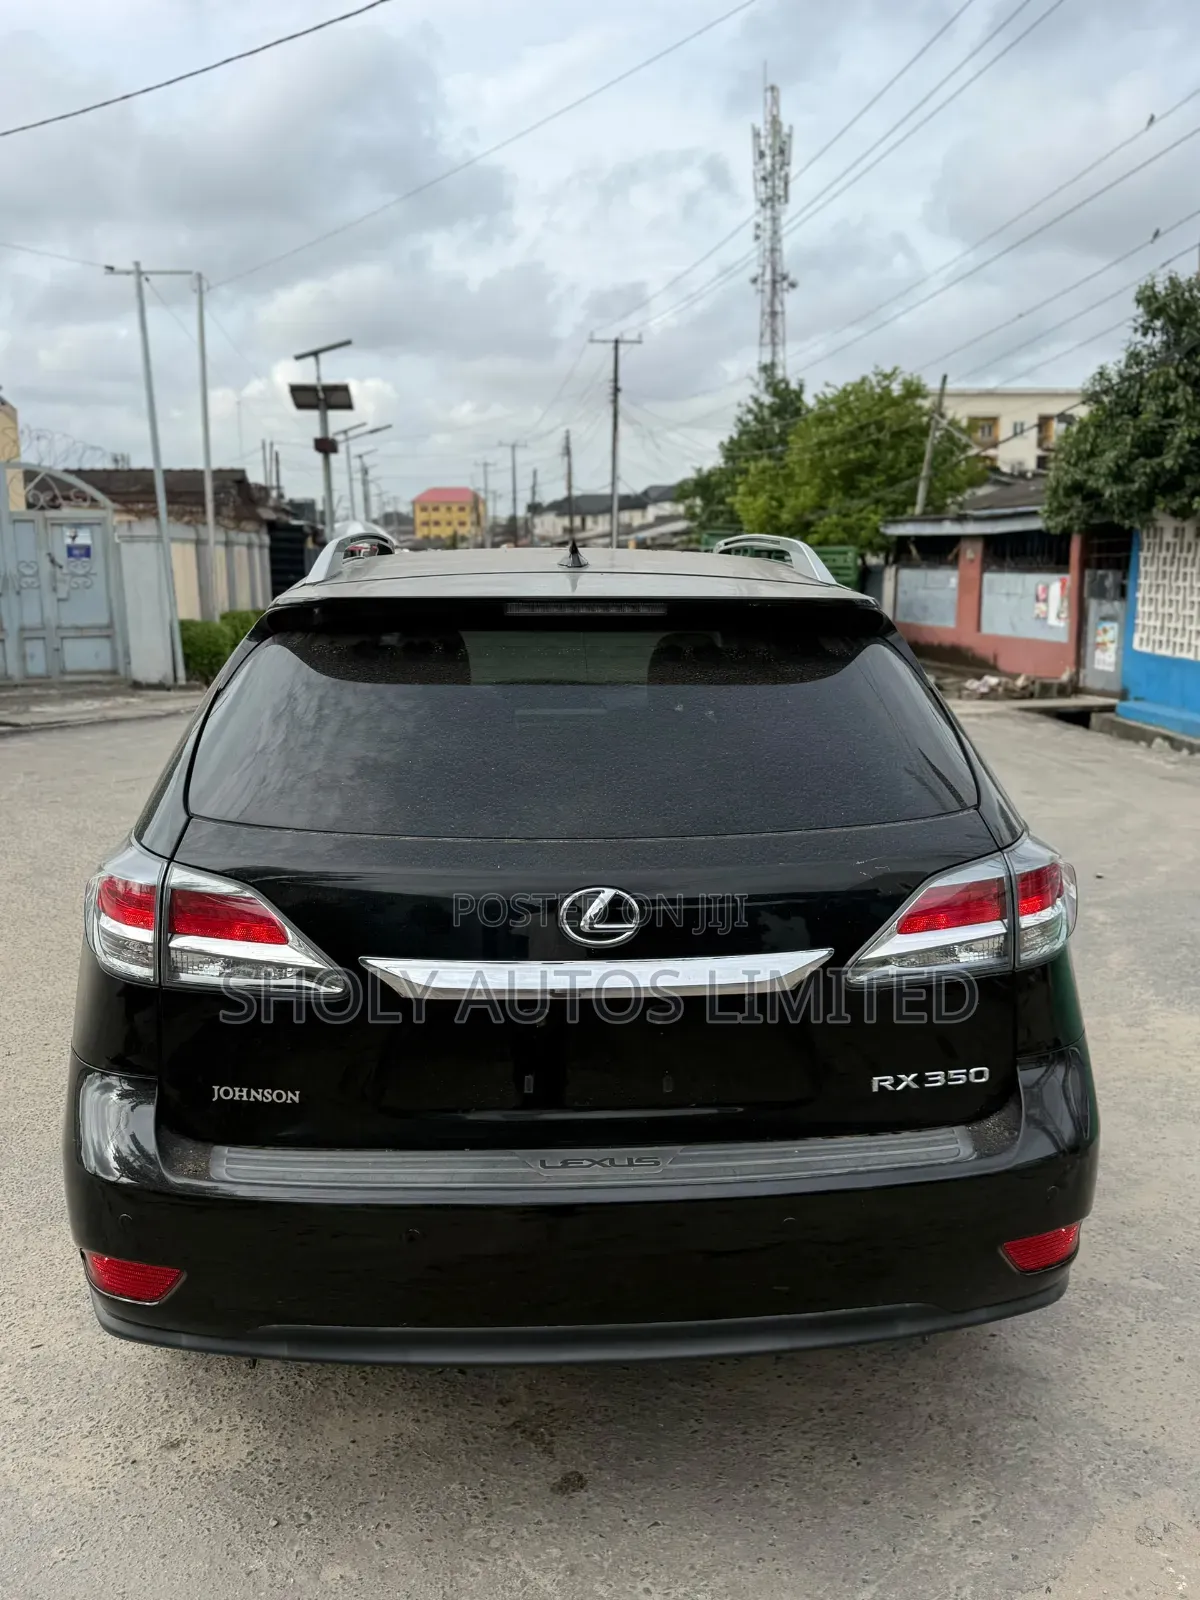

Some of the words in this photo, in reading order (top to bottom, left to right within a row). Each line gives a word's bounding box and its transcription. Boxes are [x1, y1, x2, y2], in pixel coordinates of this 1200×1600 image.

[871, 1072, 920, 1093] RX
[924, 1066, 990, 1088] 350
[211, 1085, 301, 1104] JOHNSON
[539, 1156, 661, 1170] LEXUS
